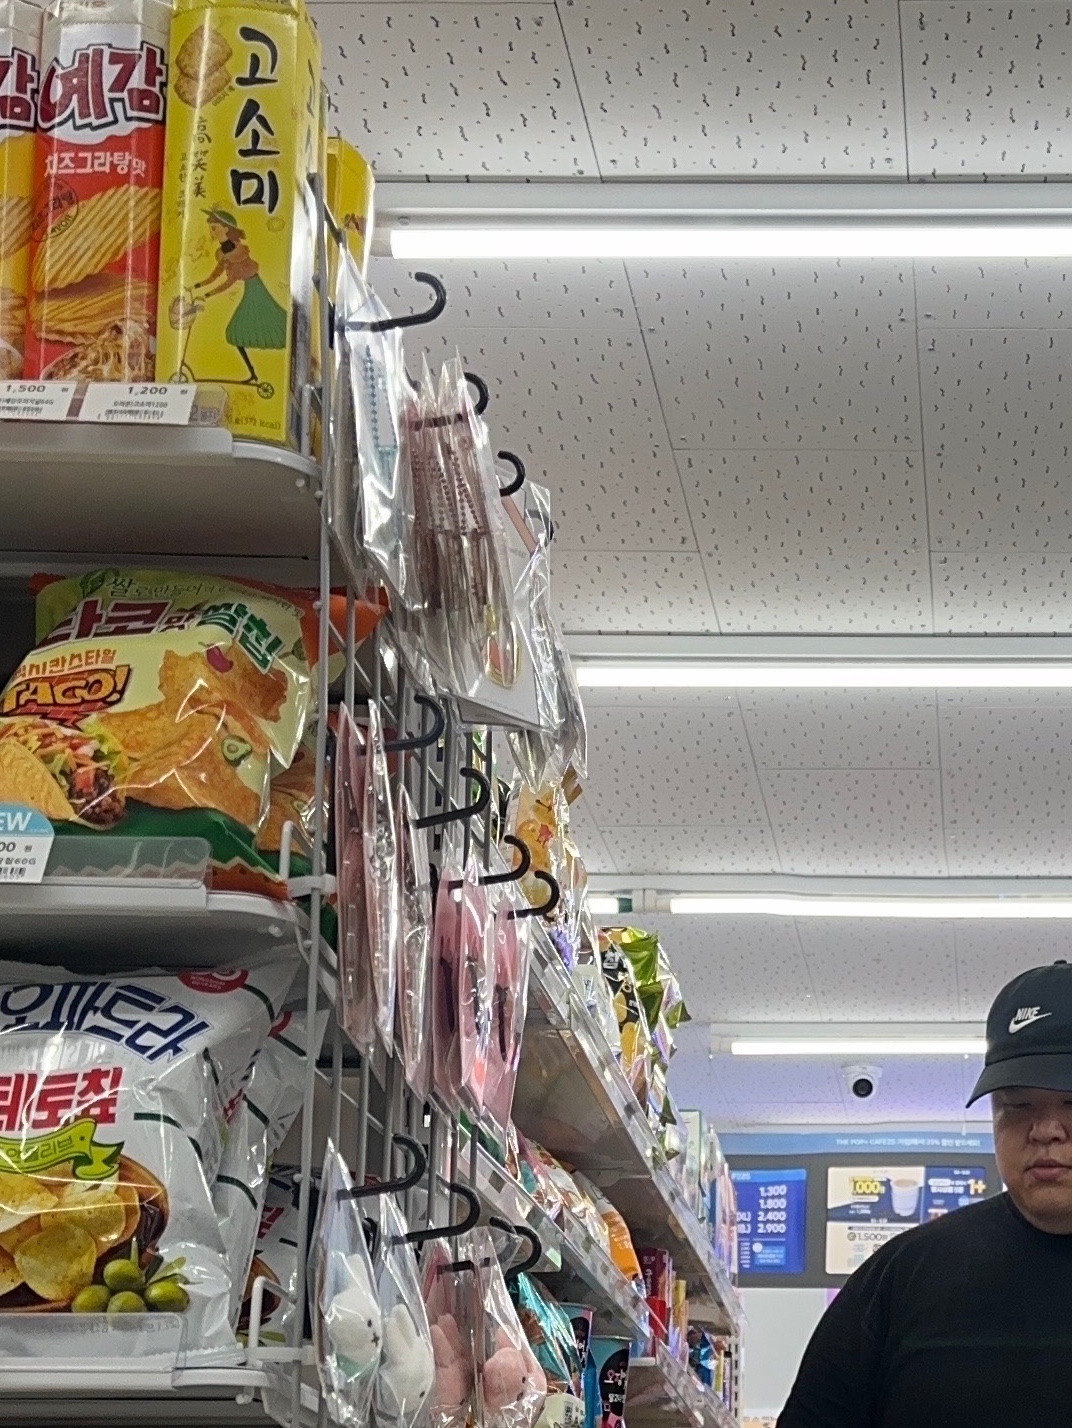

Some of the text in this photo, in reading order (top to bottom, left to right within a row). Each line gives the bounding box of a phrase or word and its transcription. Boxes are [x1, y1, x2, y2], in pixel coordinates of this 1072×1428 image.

[38, 42, 168, 131] 예감
[230, 26, 281, 214] 고소미
[5, 385, 46, 393] 1,500
[128, 386, 168, 395] 1,200
[2, 664, 131, 713] TACO!
[0, 812, 32, 831] EW
[1015, 1006, 1041, 1021] NIKE
